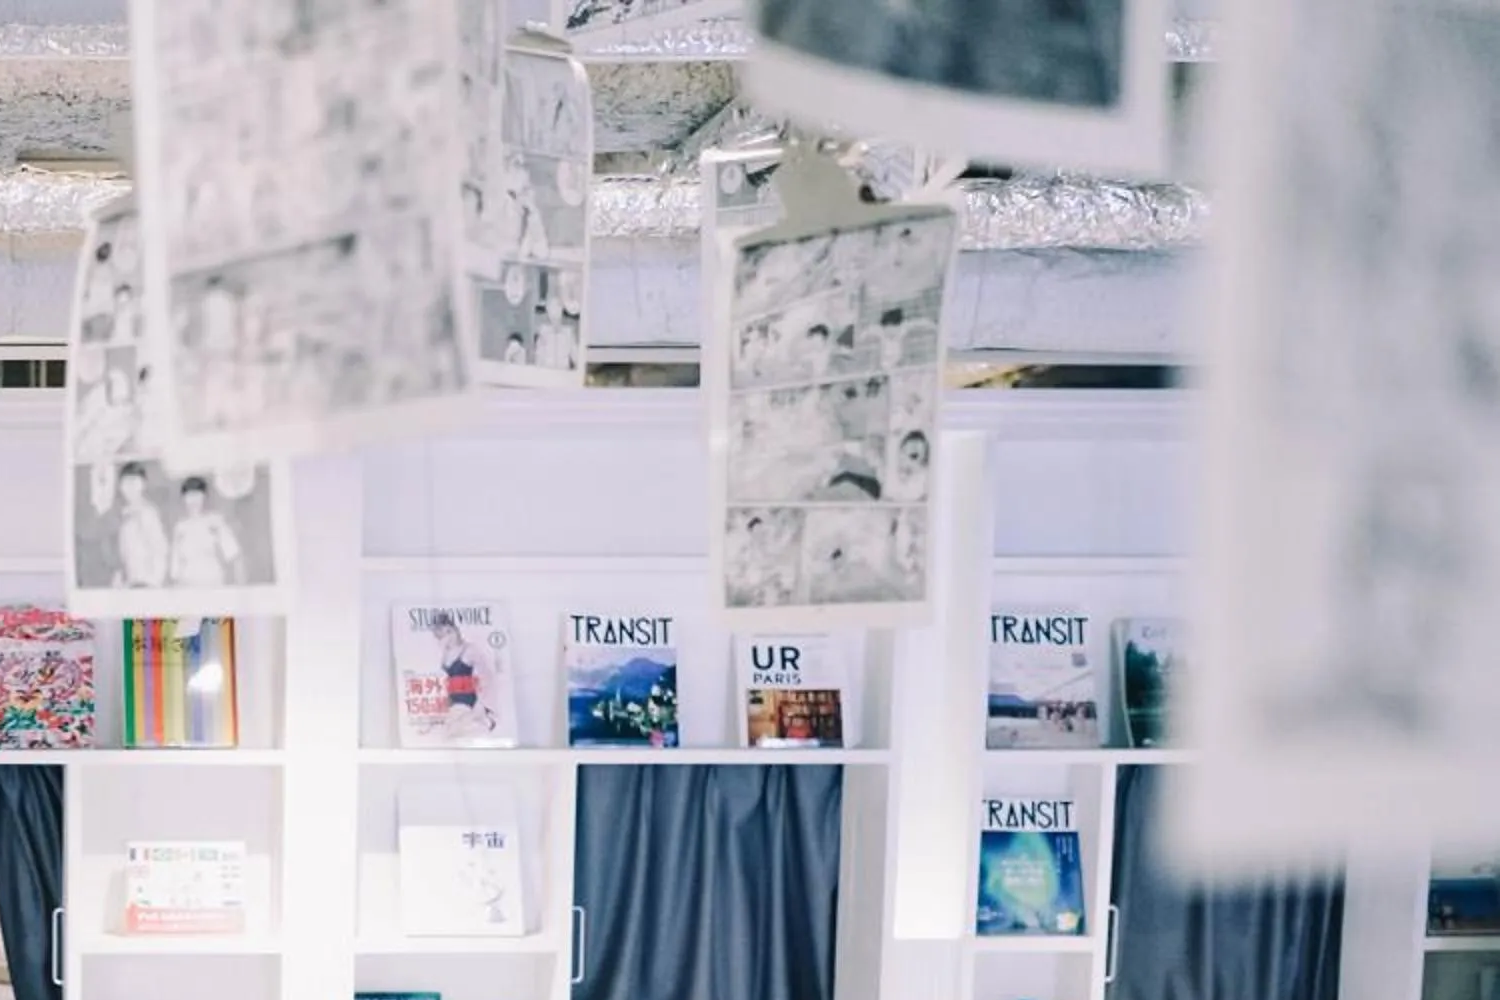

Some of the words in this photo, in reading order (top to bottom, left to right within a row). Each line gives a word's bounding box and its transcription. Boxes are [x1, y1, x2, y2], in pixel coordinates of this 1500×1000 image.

[456, 606, 492, 626] VOICE
[570, 615, 672, 645] TRANSIT
[990, 615, 1089, 645] TRANSIT
[752, 645, 801, 671] UR
[753, 673, 802, 685] PARIS
[982, 799, 1074, 829] RANSIT
[461, 831, 506, 849] 宇宙
